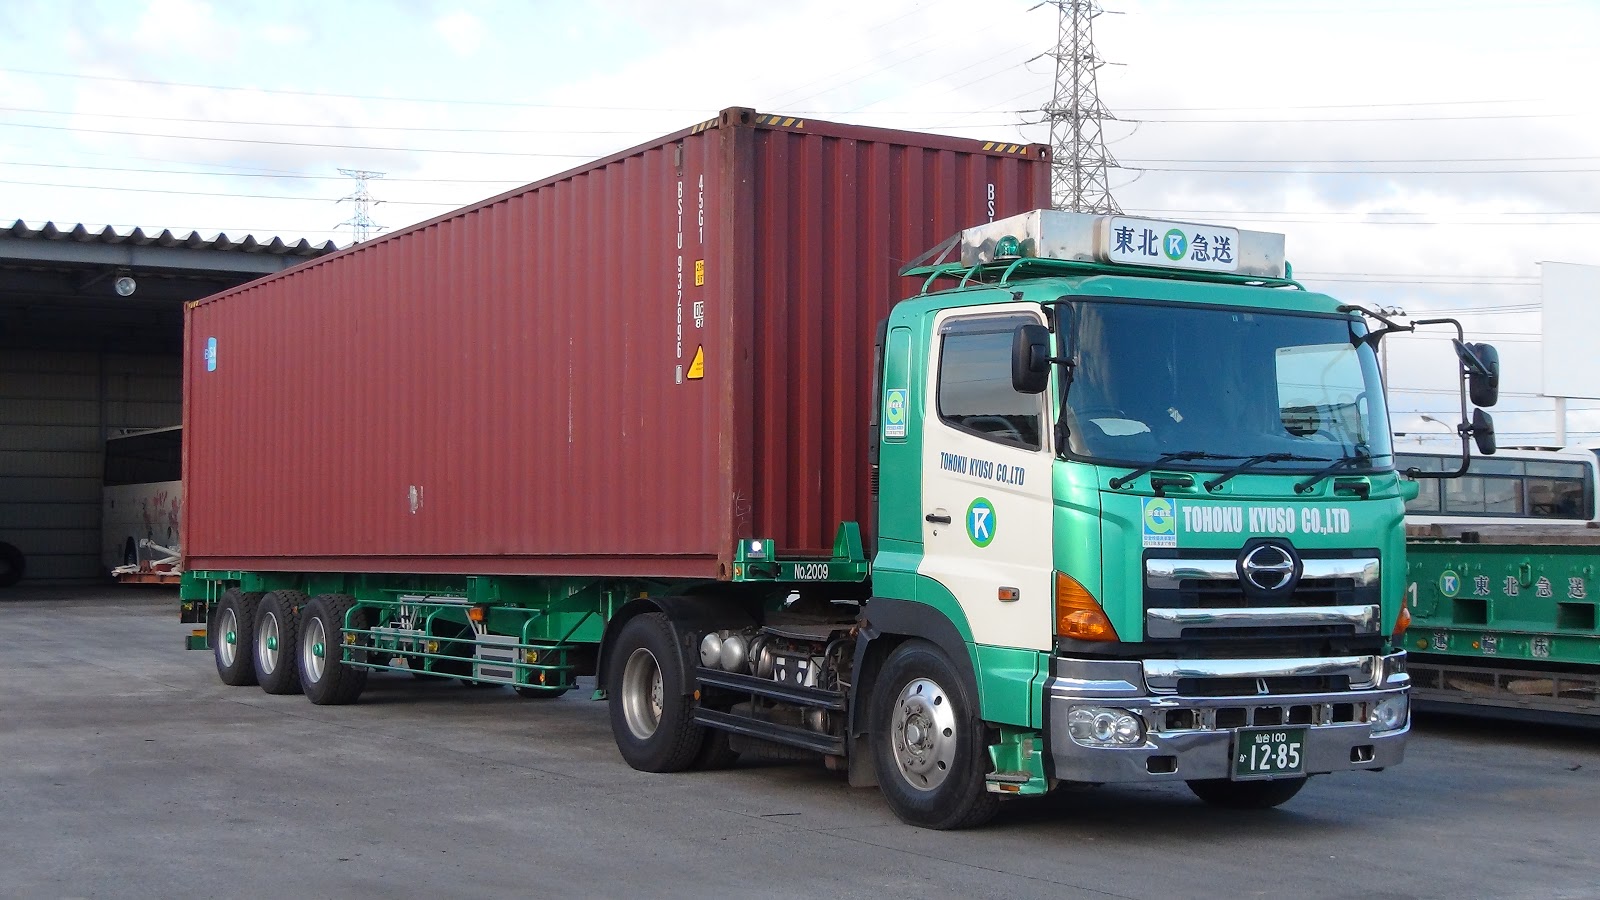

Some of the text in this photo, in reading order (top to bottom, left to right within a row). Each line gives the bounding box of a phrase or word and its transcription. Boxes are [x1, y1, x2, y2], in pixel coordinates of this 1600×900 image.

[1113, 225, 1159, 257] 東北
[1190, 233, 1234, 264] 急送
[940, 451, 968, 475] TOHOKU
[969, 457, 994, 480] KYUSO
[1182, 506, 1350, 536] TOHOKU KYUSO CO.,LTD
[794, 563, 829, 580] No.2009
[1473, 574, 1586, 599] 東北急送
[1271, 732, 1287, 742] 100
[1250, 742, 1301, 771] 12-85
